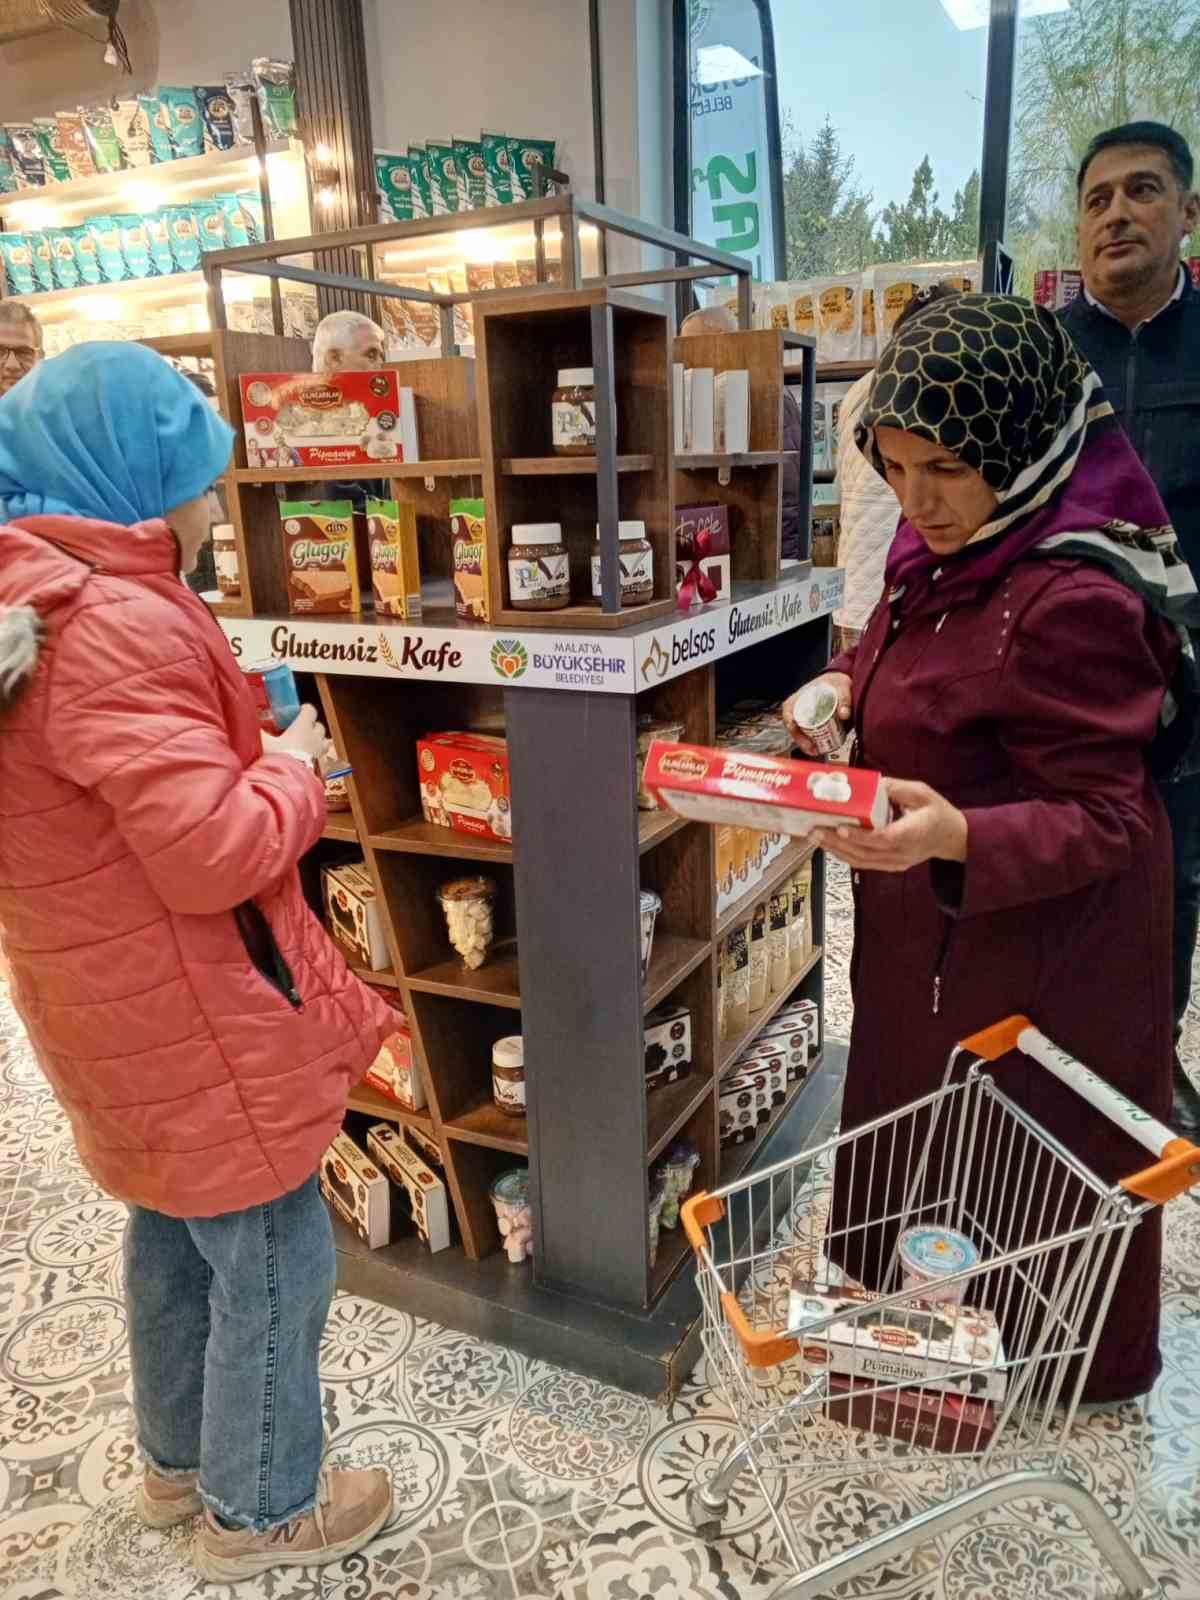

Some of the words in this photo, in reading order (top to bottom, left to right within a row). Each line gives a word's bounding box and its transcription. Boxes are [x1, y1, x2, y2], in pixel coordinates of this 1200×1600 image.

[292, 540, 349, 566] Glugof
[729, 601, 774, 644] Glutensiz
[780, 592, 802, 623] Kafe
[271, 625, 378, 663] Glutensiz
[401, 636, 463, 672] Kafe
[554, 642, 603, 654] MALATYA
[672, 627, 715, 666] belsos
